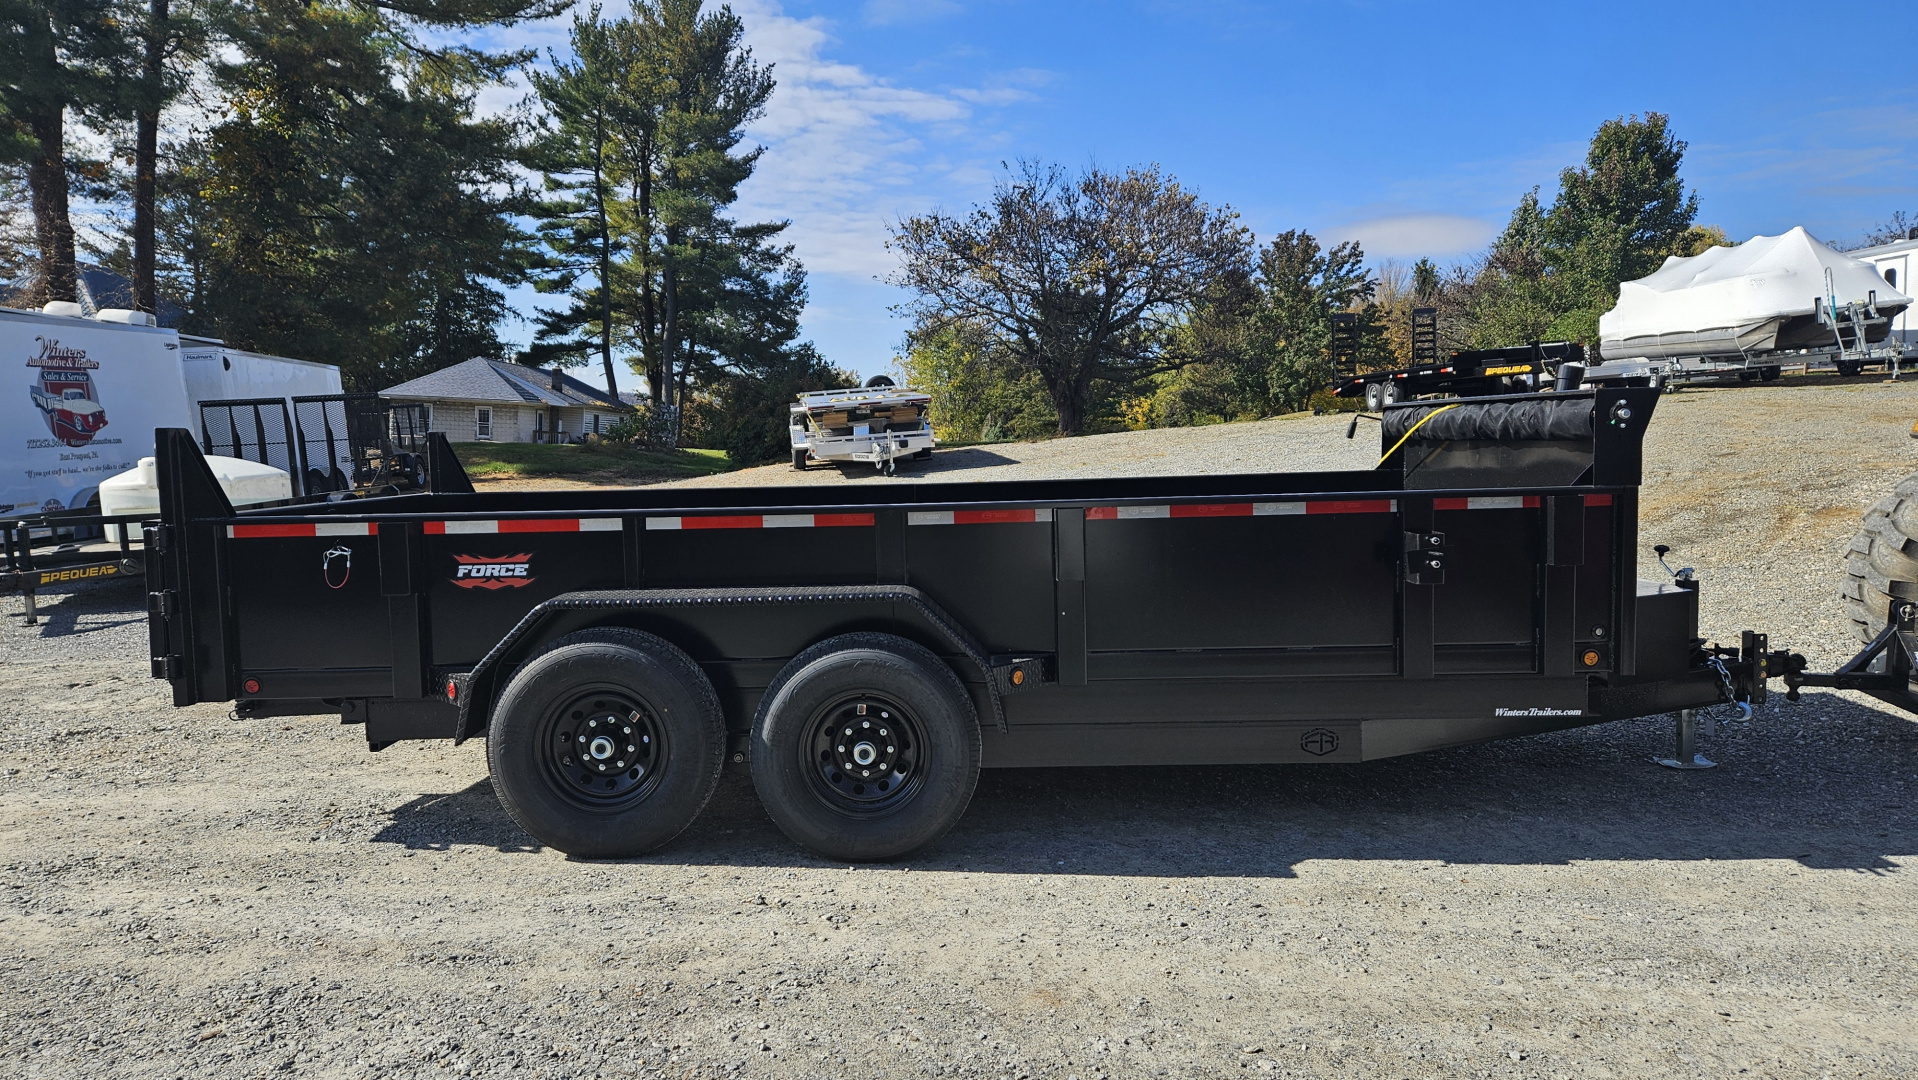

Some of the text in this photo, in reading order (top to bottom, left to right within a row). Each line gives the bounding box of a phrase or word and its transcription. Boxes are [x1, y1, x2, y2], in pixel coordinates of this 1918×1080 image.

[35, 335, 86, 358] Winters
[25, 355, 99, 369] Automotive & Trailers
[43, 371, 87, 382] Sales & Service
[50, 566, 107, 581] PEQUEA
[457, 563, 529, 577] FORCE
[1495, 707, 1582, 717] WintersTrailers.com
